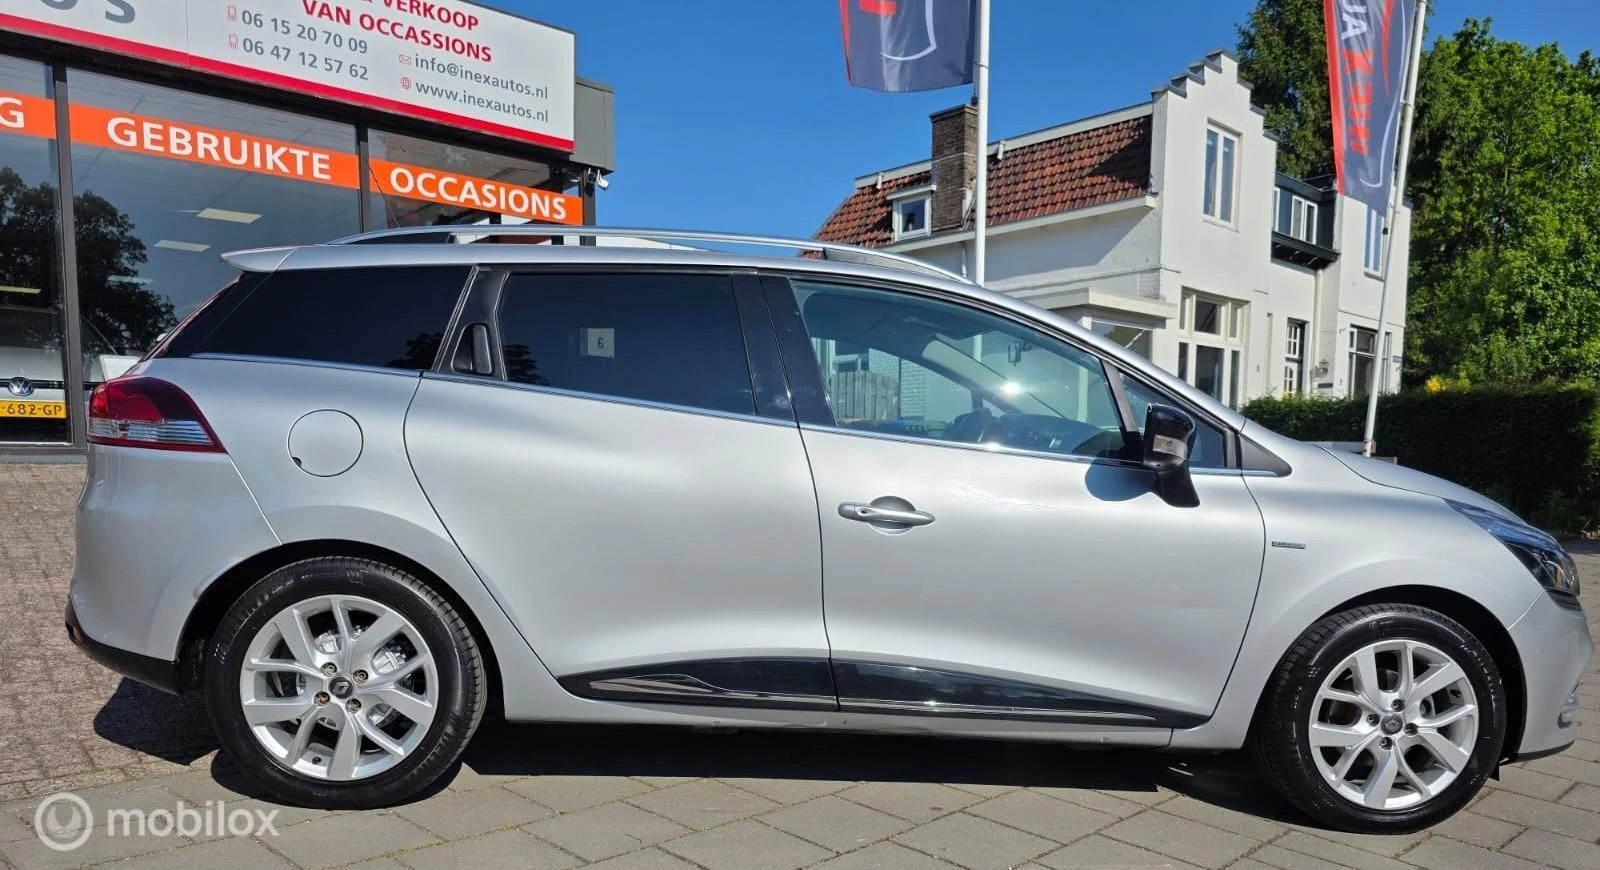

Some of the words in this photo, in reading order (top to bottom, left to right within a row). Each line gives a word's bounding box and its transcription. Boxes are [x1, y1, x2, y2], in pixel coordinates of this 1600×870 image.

[241, 10, 263, 28] 06
[271, 18, 291, 35] 15
[296, 24, 317, 41] 20
[323, 30, 343, 48] 70
[348, 37, 368, 54] 09
[302, 0, 351, 26] VAN
[359, 13, 492, 62] OCCASSIONS
[383, 0, 479, 31] VERKOOP
[242, 38, 264, 56] 06
[270, 45, 291, 62] 47
[299, 51, 318, 69] 12
[324, 57, 343, 74] 57
[350, 63, 369, 81] 62
[415, 53, 549, 99] info@inexautos.nl
[415, 82, 549, 122] www.inexautos.nl
[106, 117, 331, 181] GEBRUIKTE
[390, 167, 567, 220] OCCASIONS
